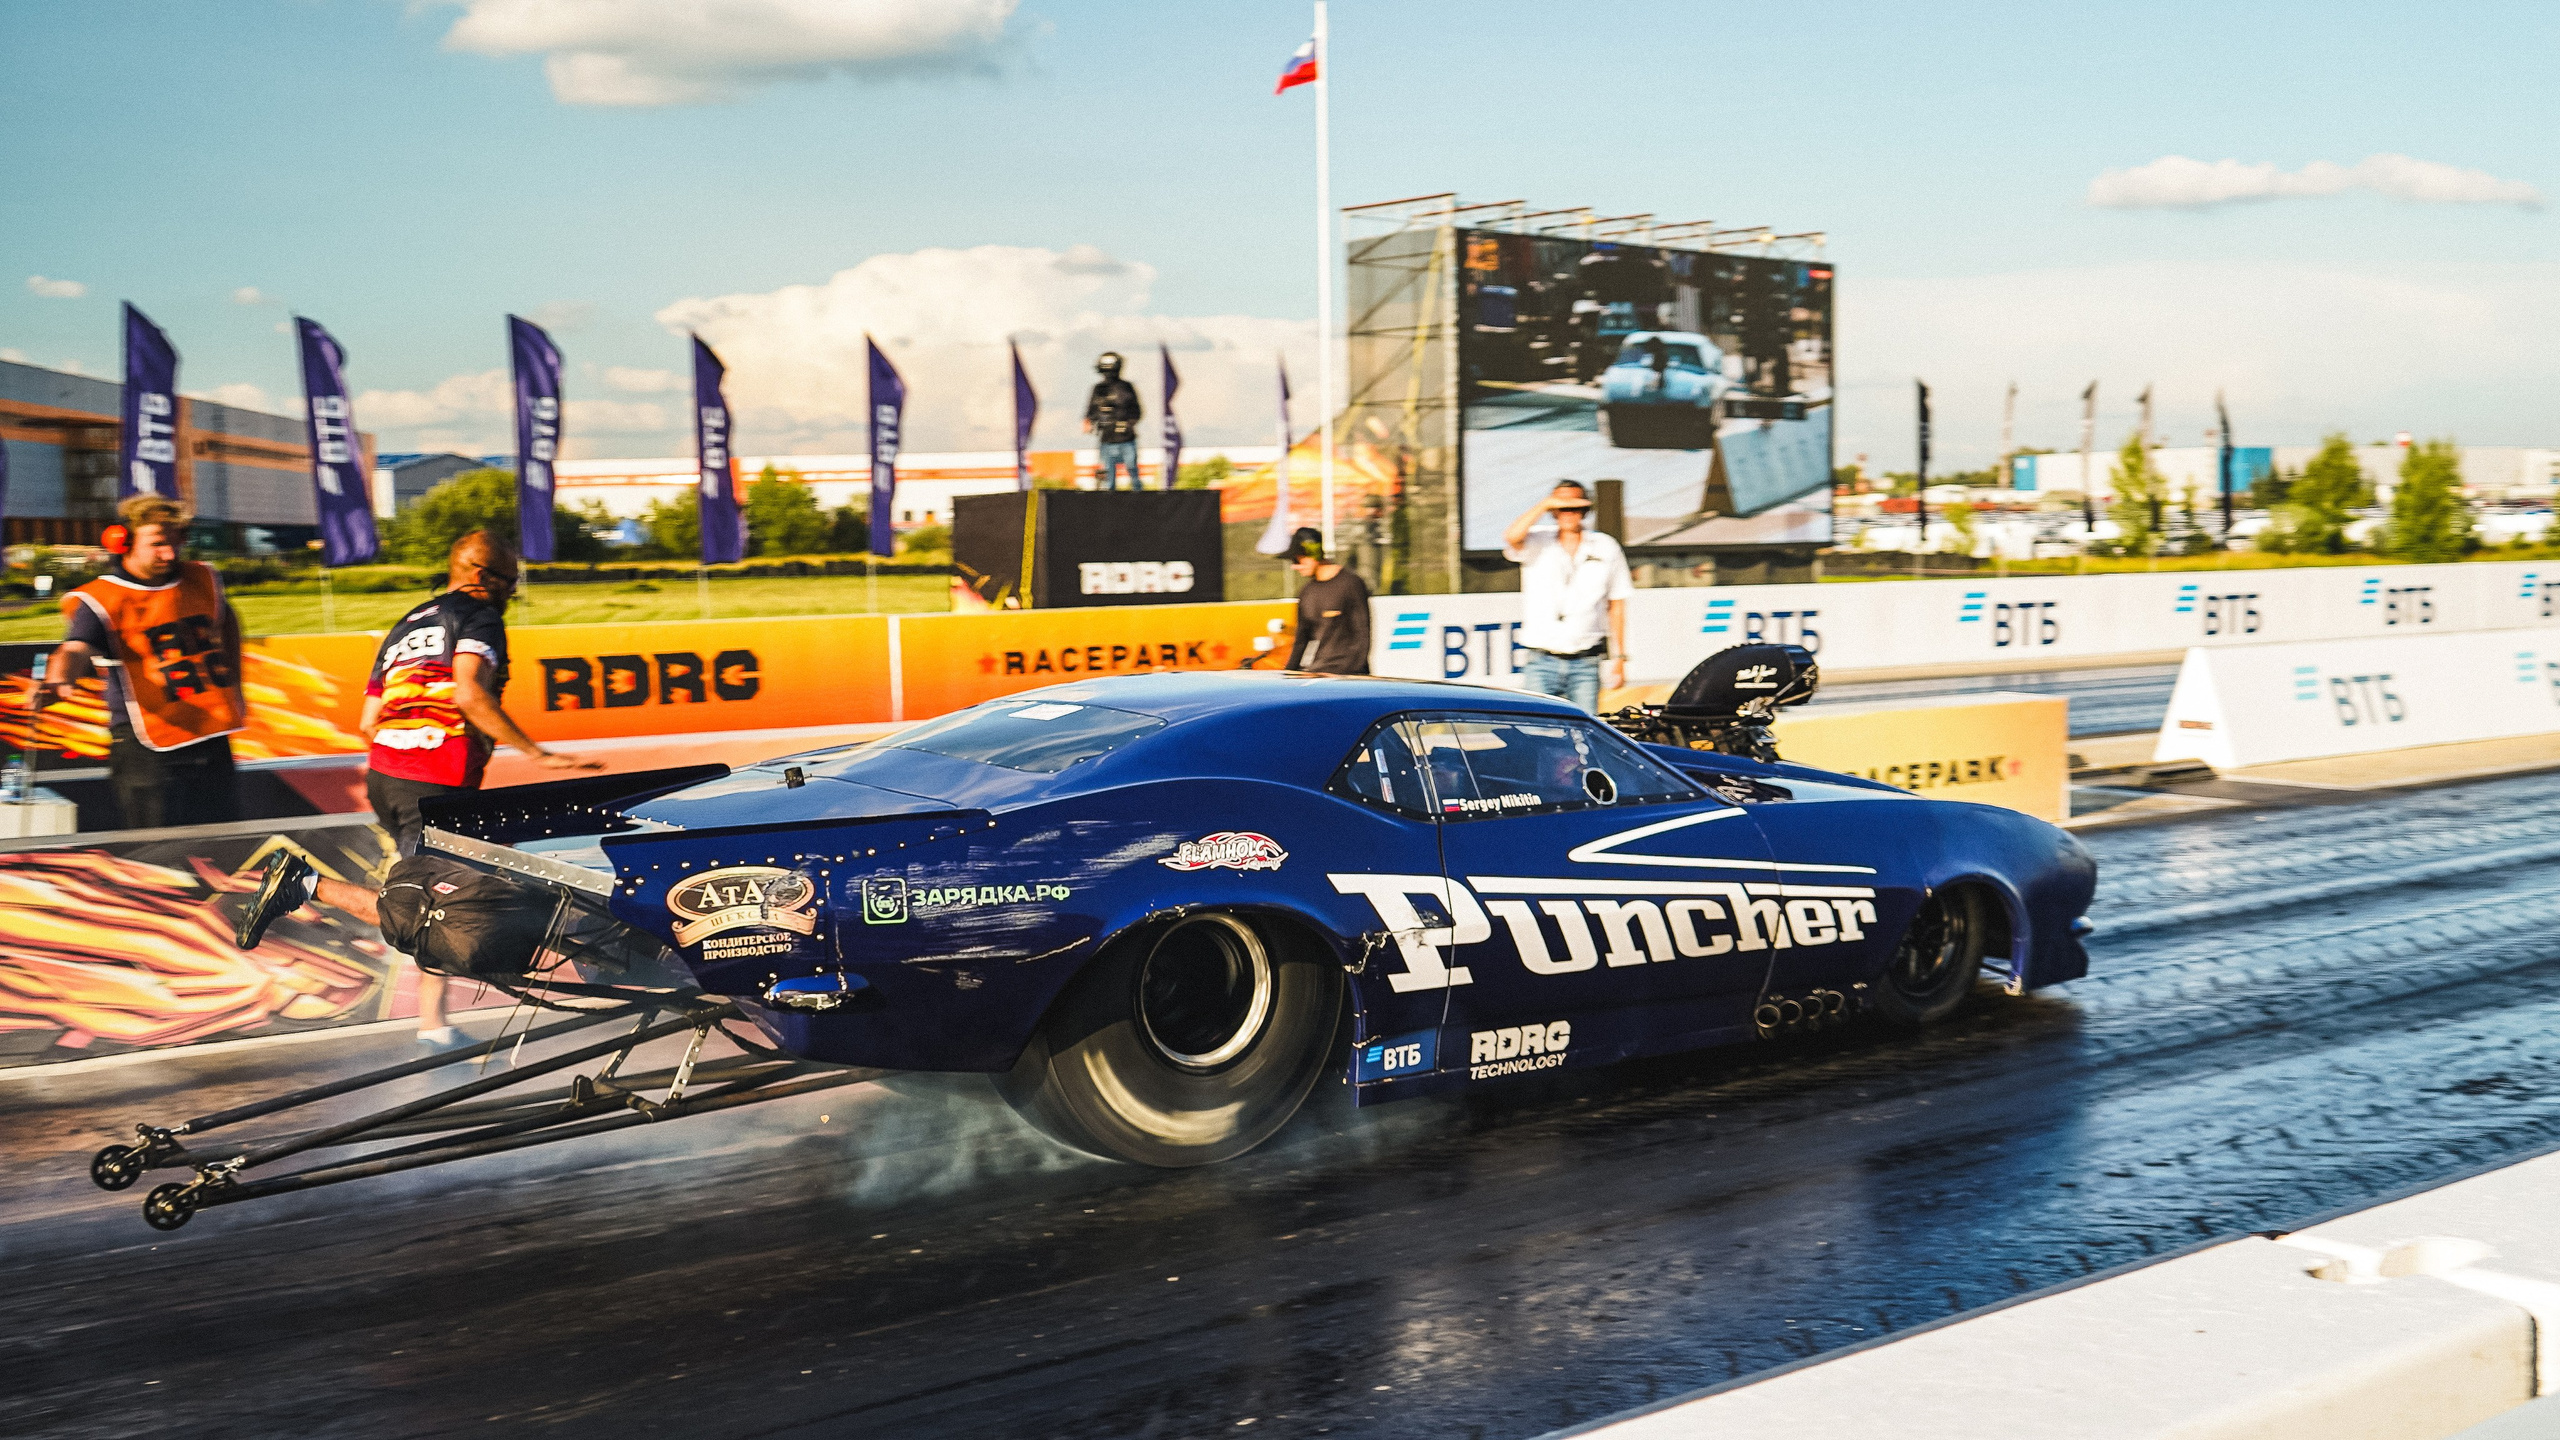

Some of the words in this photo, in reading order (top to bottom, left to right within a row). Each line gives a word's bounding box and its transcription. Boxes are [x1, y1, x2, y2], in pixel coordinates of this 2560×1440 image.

[2203, 594, 2262, 635] ВТБ
[2384, 586, 2436, 625] ВТБ
[1993, 601, 2060, 647] ВТБ
[1004, 641, 1205, 674] RACEPARK
[2329, 673, 2408, 726] ВТБ
[1846, 755, 2005, 789] CEPARK
[1459, 798, 1500, 812] Sergey
[1500, 793, 1542, 808] Nikitin
[911, 884, 1071, 907] ЗАРЯДКА.РФ
[702, 932, 792, 950] КОНДИТЕРСКОЕ
[1327, 873, 1877, 994] Puncher
[703, 943, 793, 961] ПРОИЗВОДСТВО
[1383, 1043, 1421, 1071] ВТБ
[1471, 1020, 1571, 1064] RDRC
[1470, 1053, 1567, 1081] TECHNOLOGY
